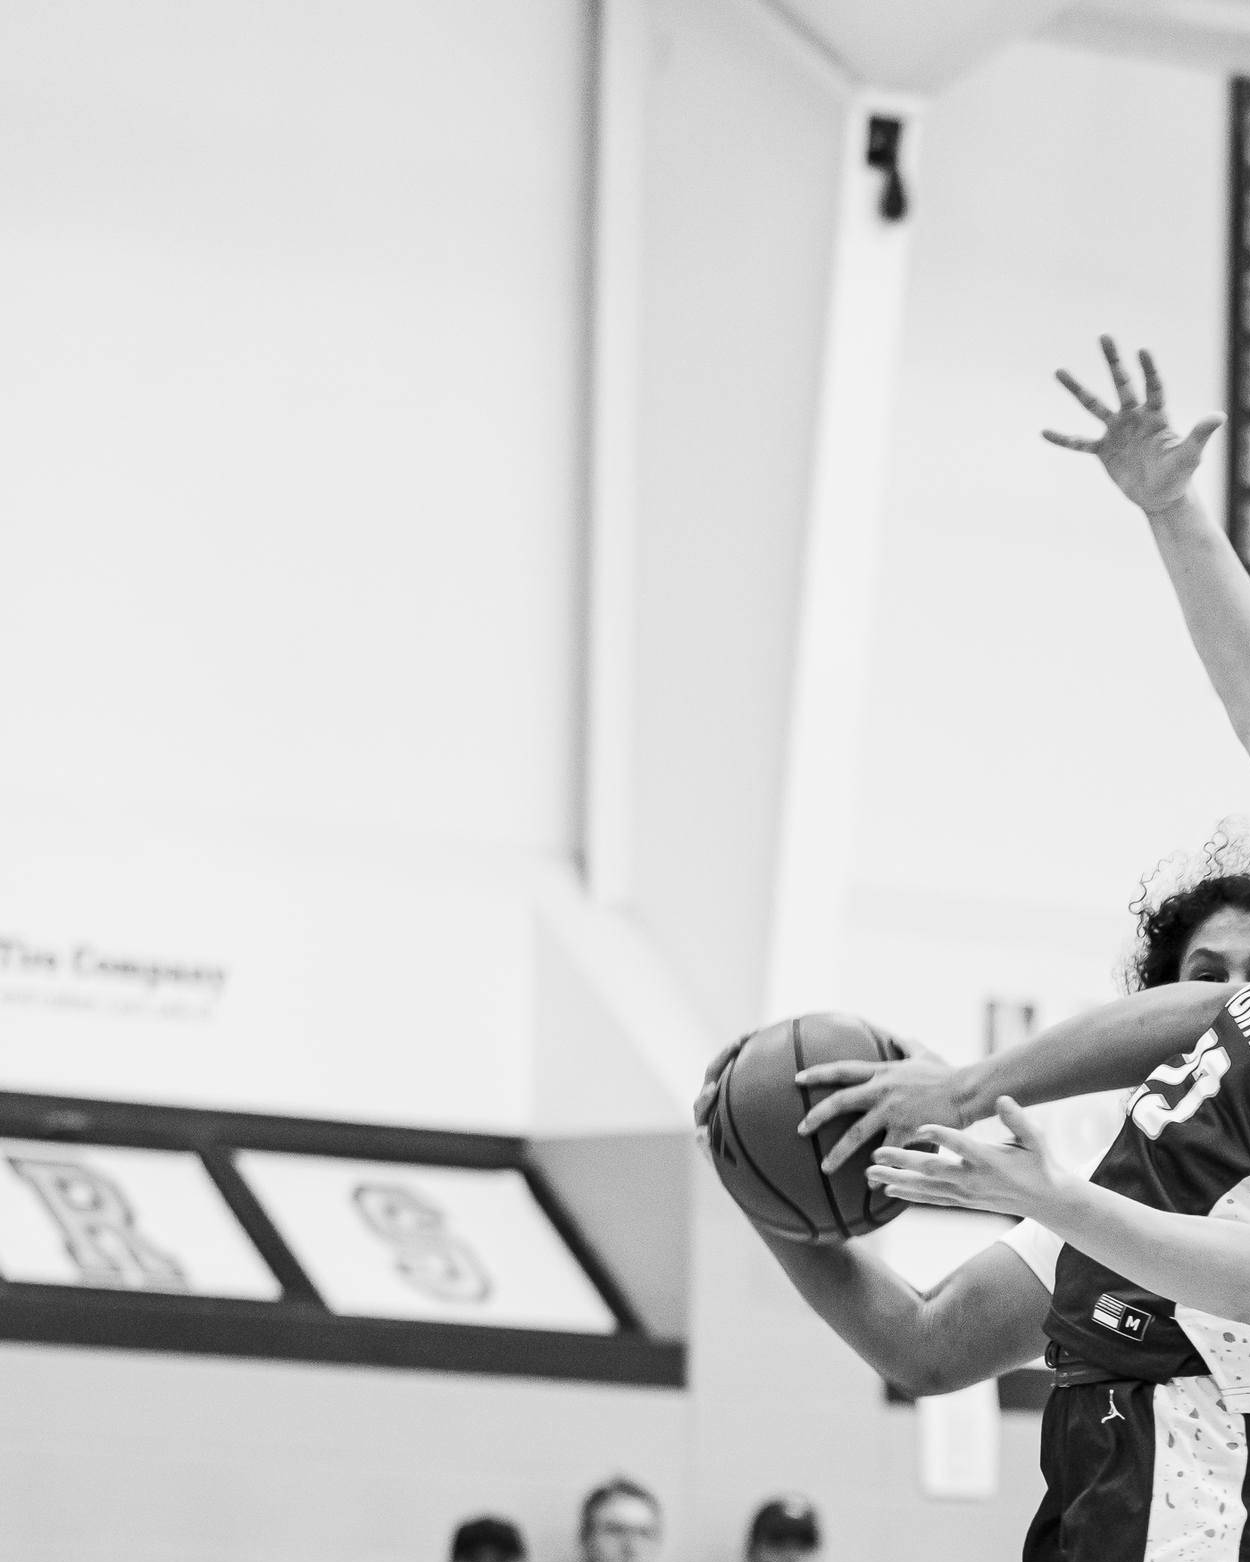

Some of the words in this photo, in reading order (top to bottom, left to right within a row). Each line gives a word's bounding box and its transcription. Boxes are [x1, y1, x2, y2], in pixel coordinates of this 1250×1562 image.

[72, 944, 229, 997] Company
[5, 1153, 192, 1290] R
[350, 1181, 493, 1305] S
[1125, 1315, 1141, 1331] M
